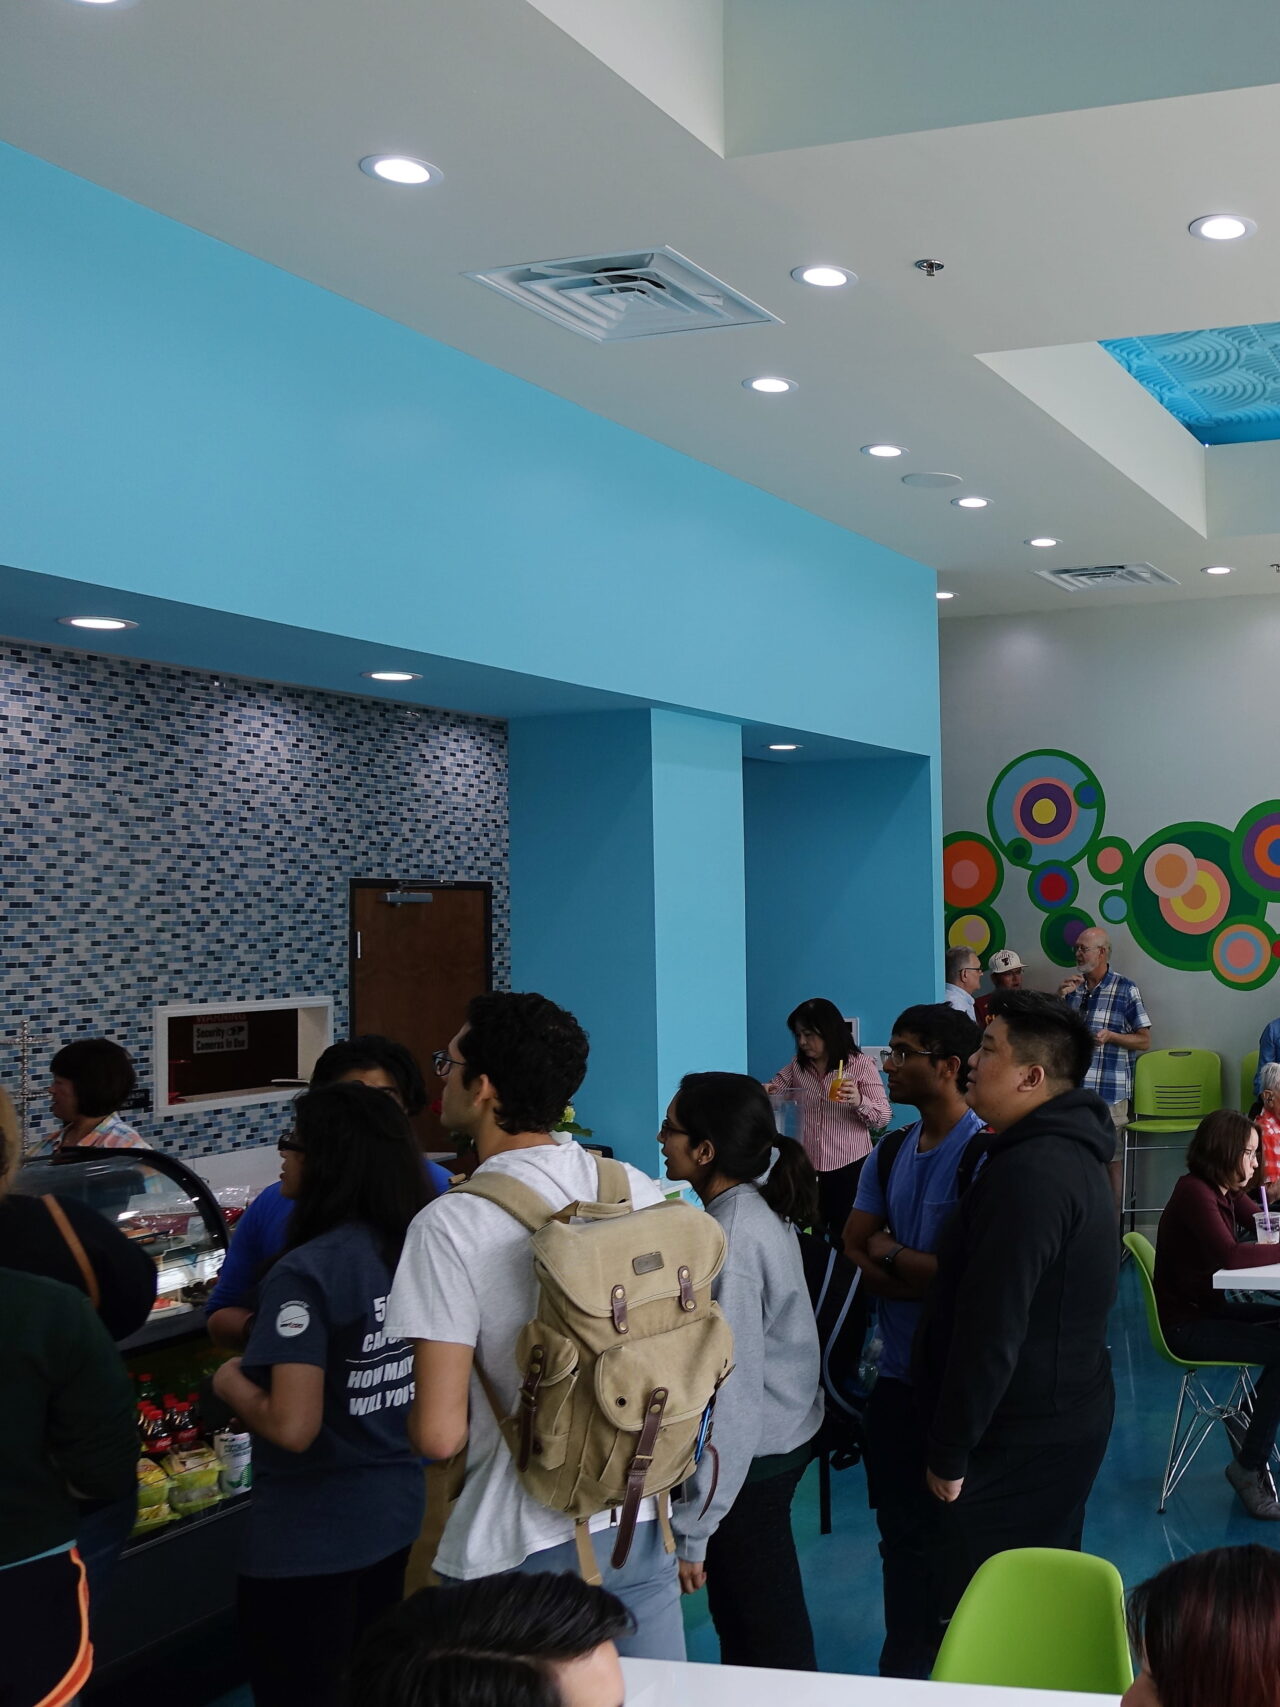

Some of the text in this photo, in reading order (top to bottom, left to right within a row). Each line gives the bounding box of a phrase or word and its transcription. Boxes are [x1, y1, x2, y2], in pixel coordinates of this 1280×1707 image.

[196, 1026, 224, 1039] Security
[196, 1040, 225, 1051] Cameras
[234, 1037, 246, 1048] Use
[347, 1366, 384, 1388] HOW
[349, 1391, 382, 1417] WILL
